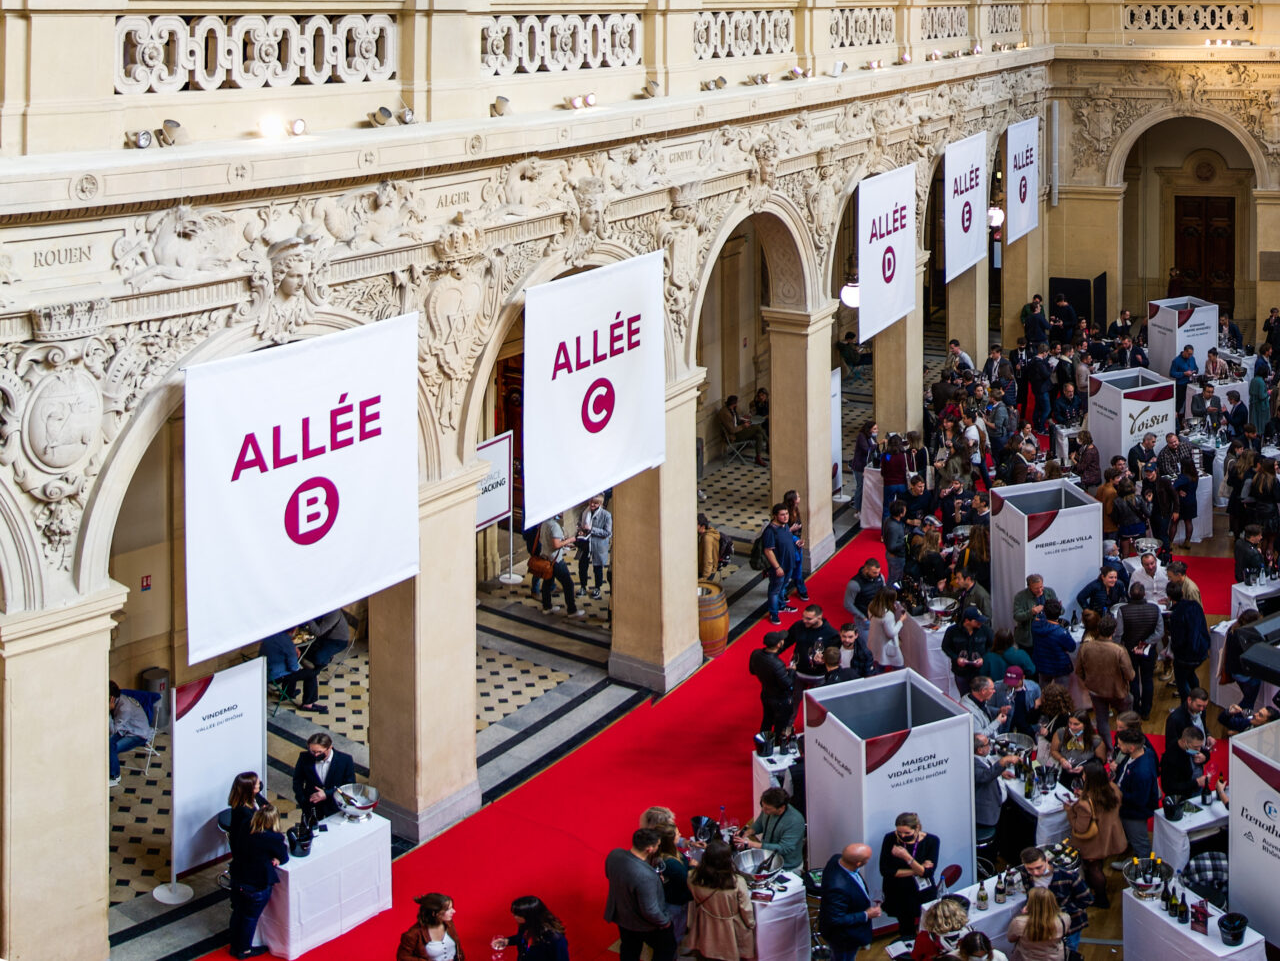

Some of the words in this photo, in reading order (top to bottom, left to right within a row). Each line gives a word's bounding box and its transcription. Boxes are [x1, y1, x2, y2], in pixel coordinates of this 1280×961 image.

[1012, 144, 1035, 171] ALLÉE
[952, 160, 980, 199] ALLÉE
[436, 190, 471, 209] ALGER
[869, 202, 907, 244] ALLÉE
[33, 245, 92, 268] ROUEN
[552, 311, 641, 380] ALLÉE
[231, 393, 382, 482] ALLÉE
[296, 486, 329, 536] B
[1075, 535, 1093, 543] VILLA
[201, 703, 238, 721] VINDEMIO
[901, 753, 937, 768] MAISON
